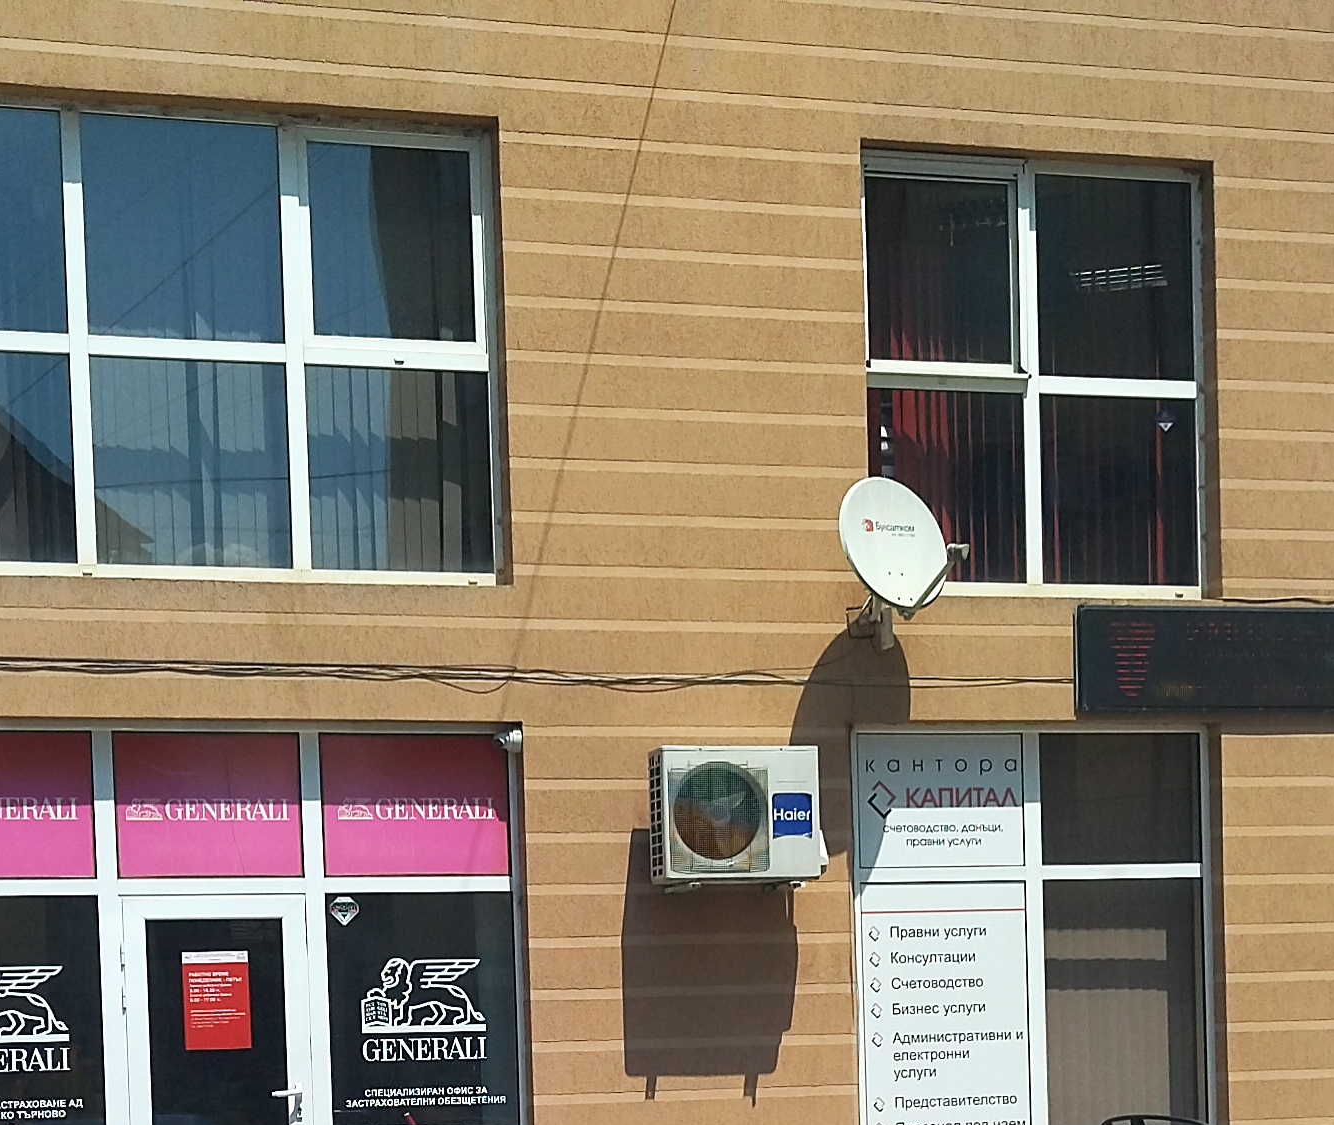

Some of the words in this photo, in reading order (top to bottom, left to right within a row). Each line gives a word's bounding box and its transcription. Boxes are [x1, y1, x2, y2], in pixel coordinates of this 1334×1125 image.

[865, 758, 1017, 776] кантора
[905, 787, 1018, 809] КАПИТАЛ
[164, 796, 290, 821] GENERALI
[375, 797, 495, 820] GENERALI
[773, 807, 811, 821] Haier
[906, 838, 945, 848] правни
[948, 837, 982, 848] услуги
[890, 926, 940, 941] Правни
[943, 926, 987, 940] услуги
[890, 951, 976, 967] Консултации
[891, 977, 984, 990] Счетоводство
[892, 1002, 940, 1015] Бизнес
[943, 1003, 986, 1016] услуги
[892, 1031, 1012, 1046] Административни
[1016, 1031, 1024, 1040] и
[362, 1036, 488, 1062] GENERALI
[893, 1049, 970, 1063] електронни
[893, 1067, 937, 1082] услуги
[364, 1087, 445, 1098] СПЕЦИАЛИЗИРАН
[446, 1086, 474, 1095] ОФИС
[475, 1086, 488, 1095] ЗА
[68, 1098, 84, 1108] АД
[345, 1097, 436, 1108] ЗАСТРАХОВАТЕЛНИ
[437, 1095, 507, 1106] ОБЕЗЩЕТЕНИЯ
[894, 1095, 1018, 1111] Представителство
[16, 1110, 67, 1120] ТЪРНОВО
